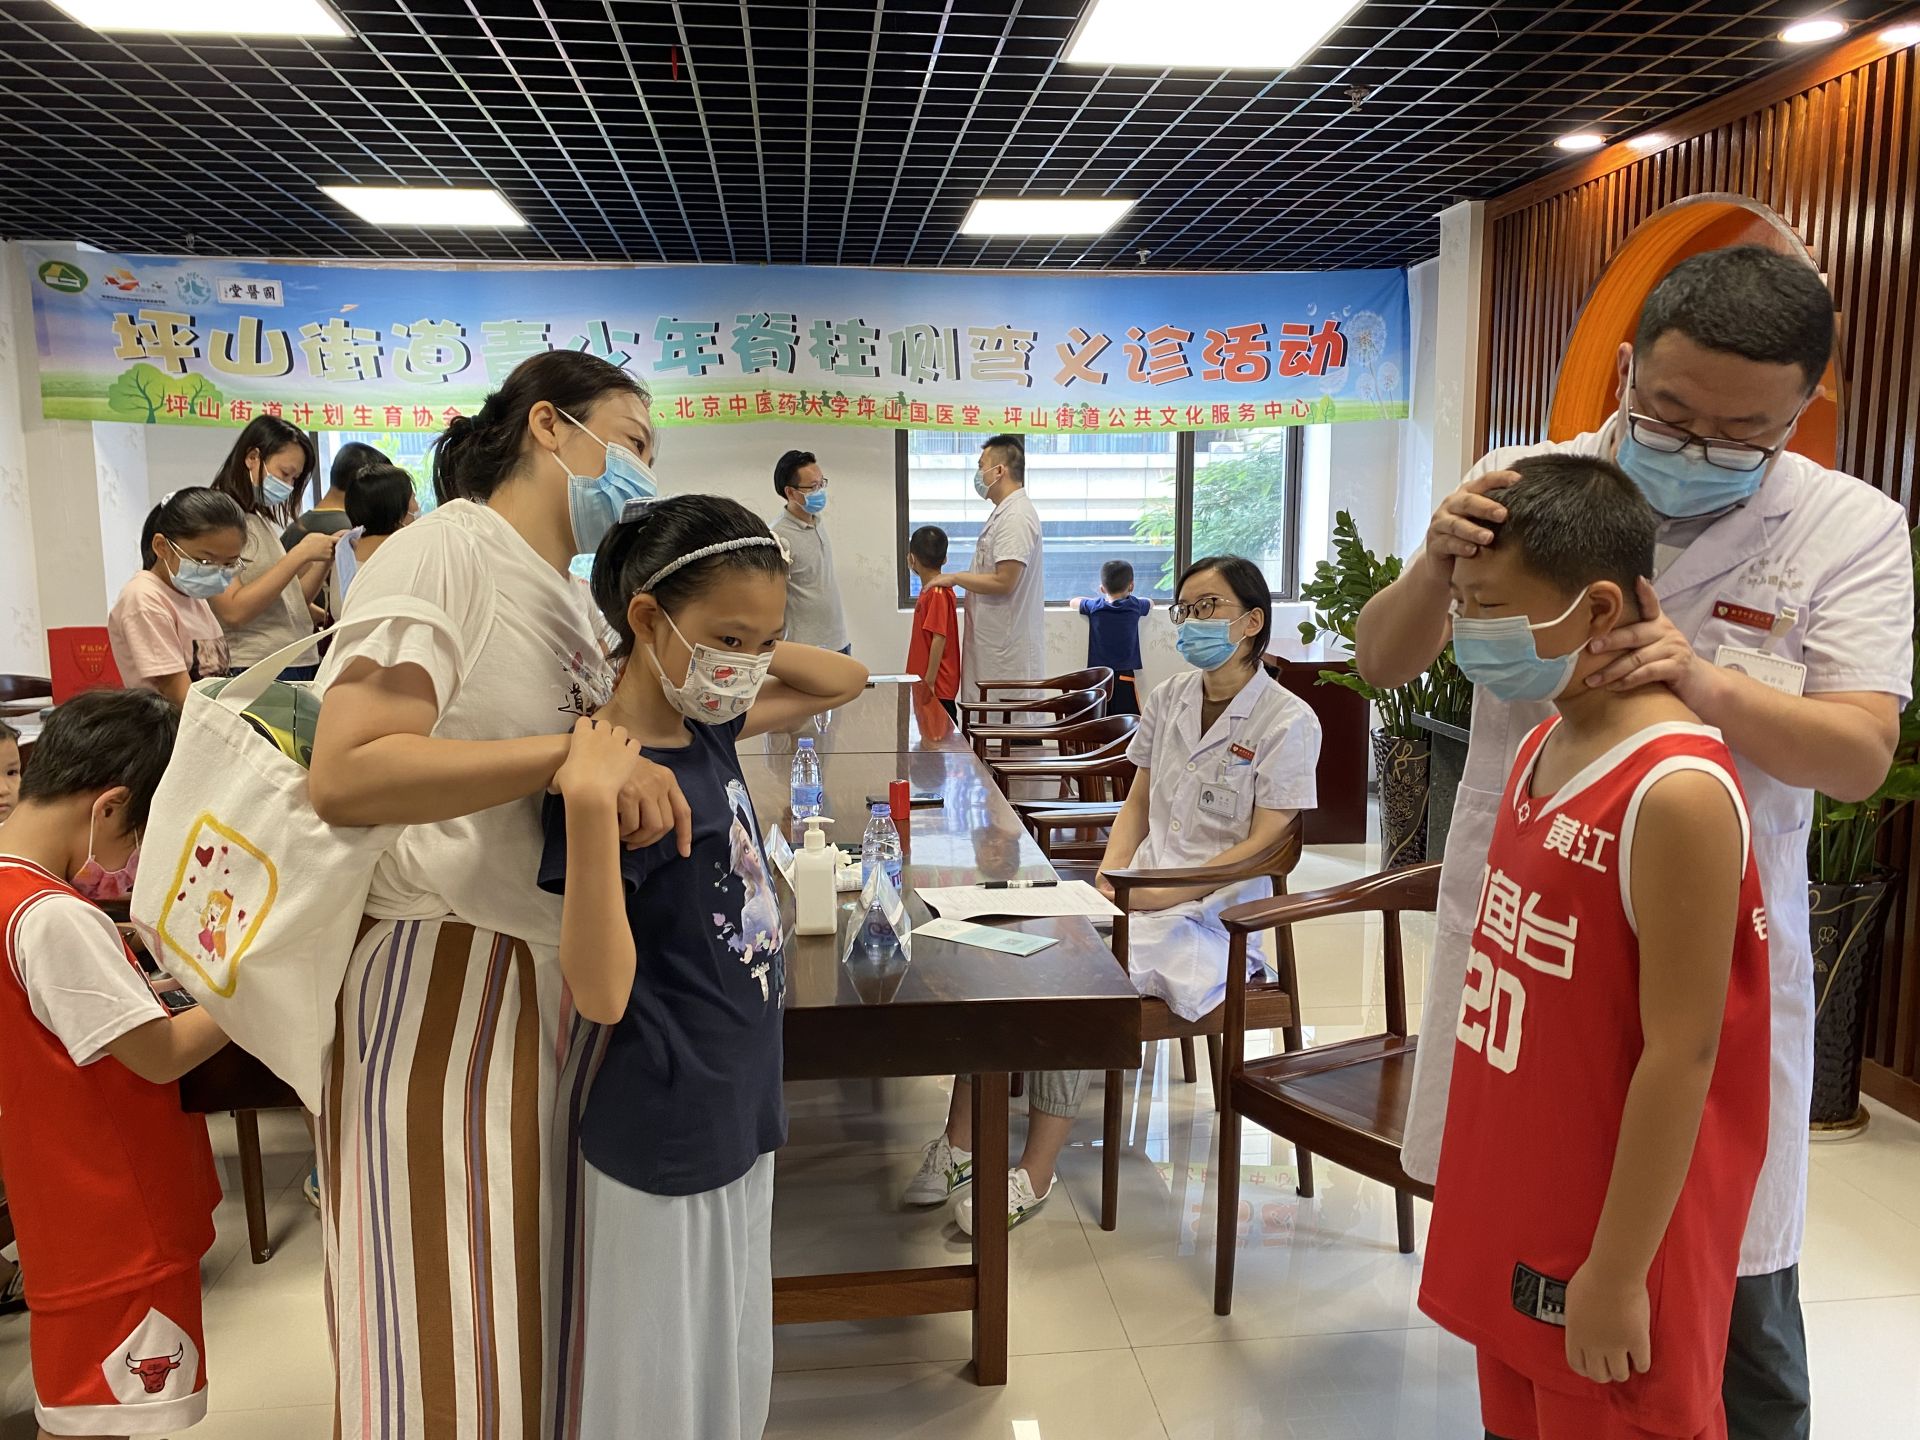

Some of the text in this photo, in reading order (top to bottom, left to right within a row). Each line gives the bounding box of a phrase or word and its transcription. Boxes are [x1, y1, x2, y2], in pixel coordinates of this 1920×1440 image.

[112, 309, 1348, 388] 坪山街道青少年脊柱侧弯义诊活动
[1543, 813, 1616, 874] 黄江
[1456, 944, 1526, 1074] 20
